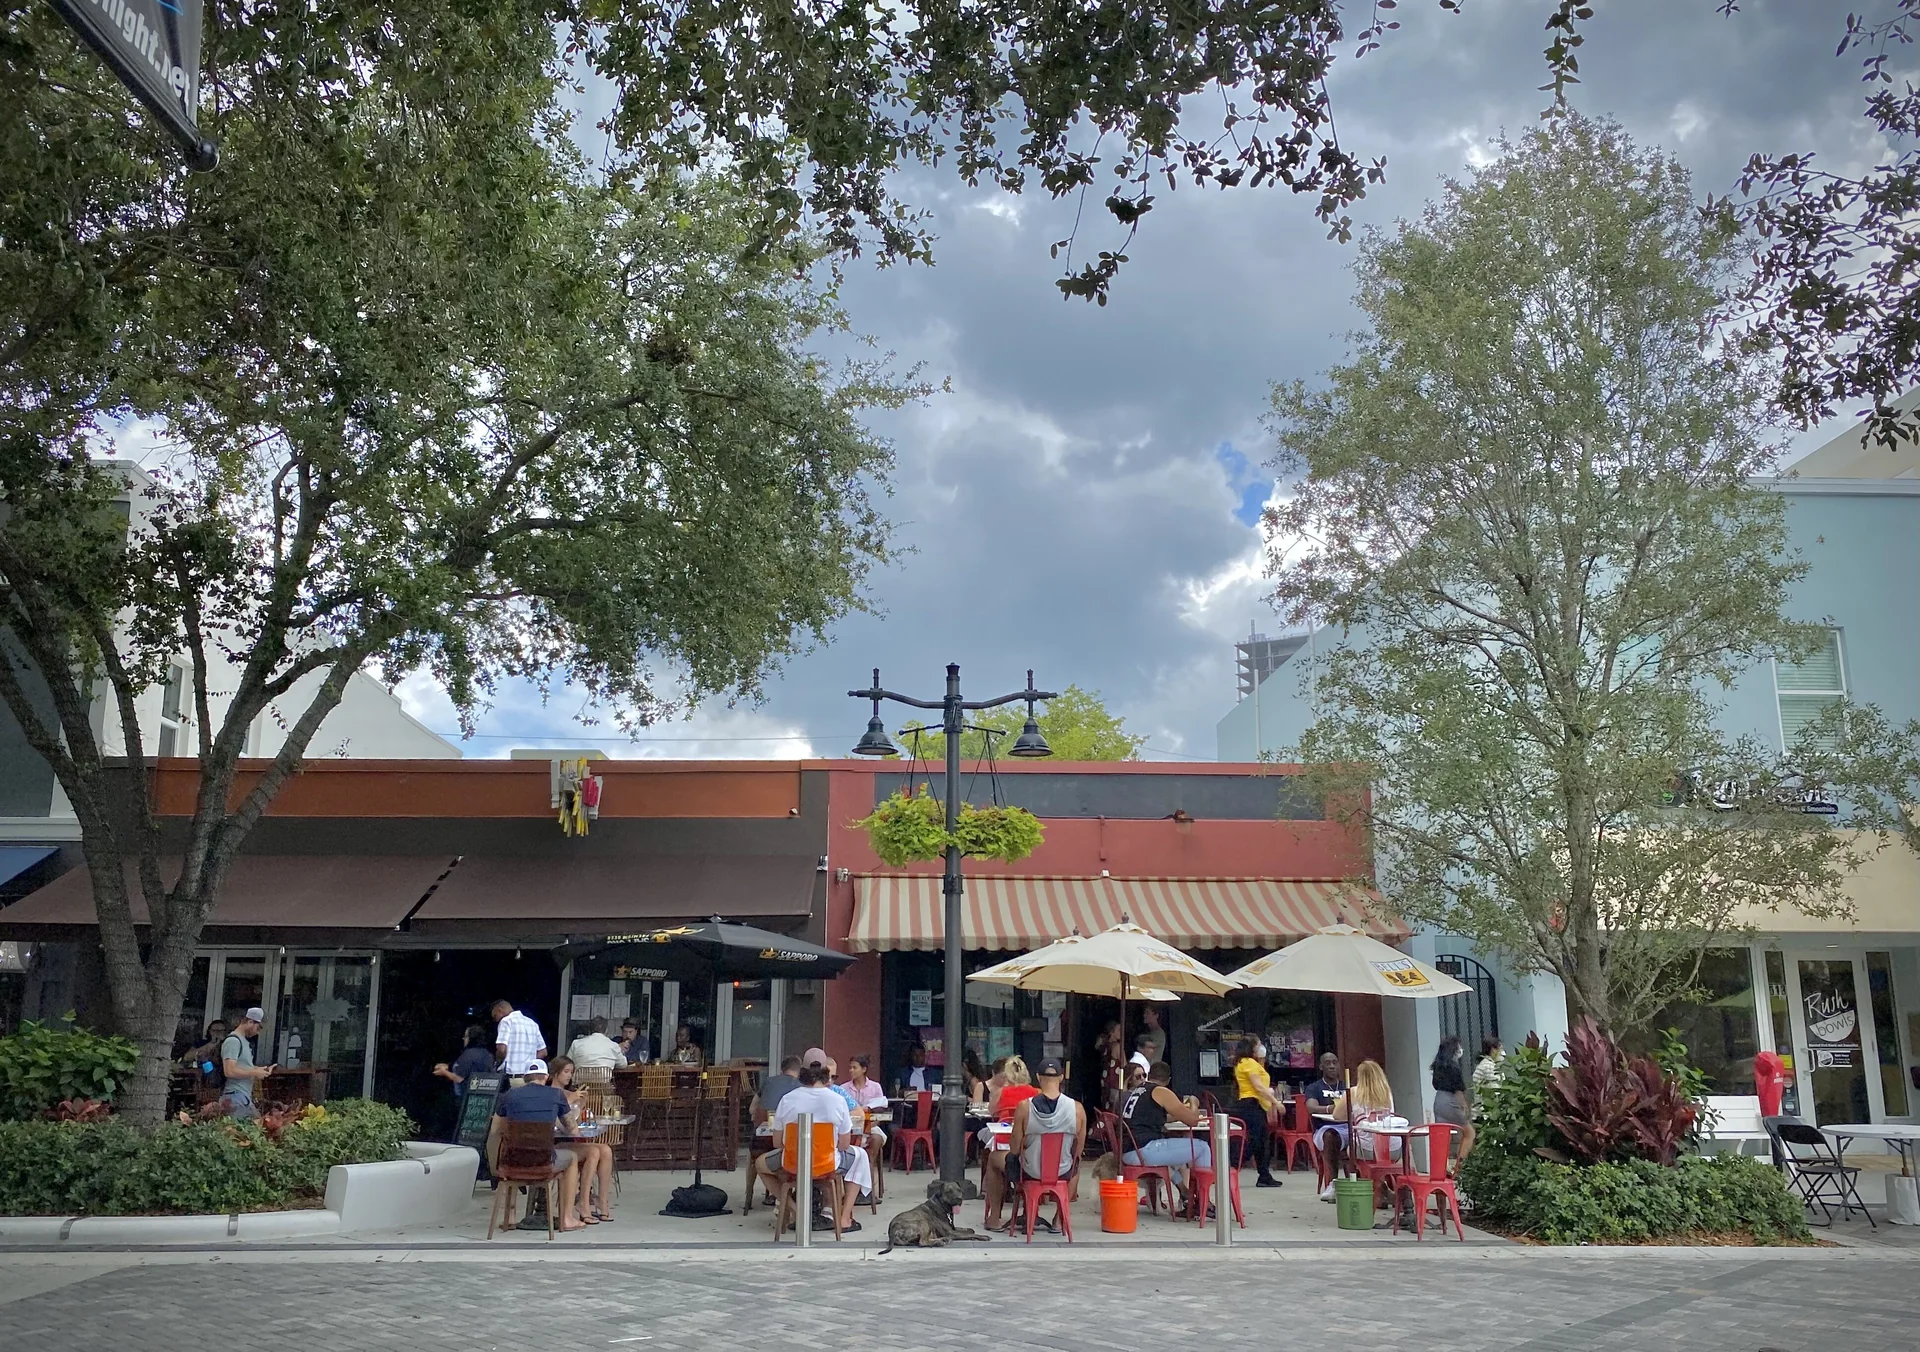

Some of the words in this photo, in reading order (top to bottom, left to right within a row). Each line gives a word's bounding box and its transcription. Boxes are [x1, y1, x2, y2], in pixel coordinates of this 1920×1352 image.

[780, 950, 818, 961] SAPPORO
[630, 967, 667, 977] SAPPORO
[1804, 989, 1849, 1018] Rush
[1815, 1013, 1855, 1037] bowls
